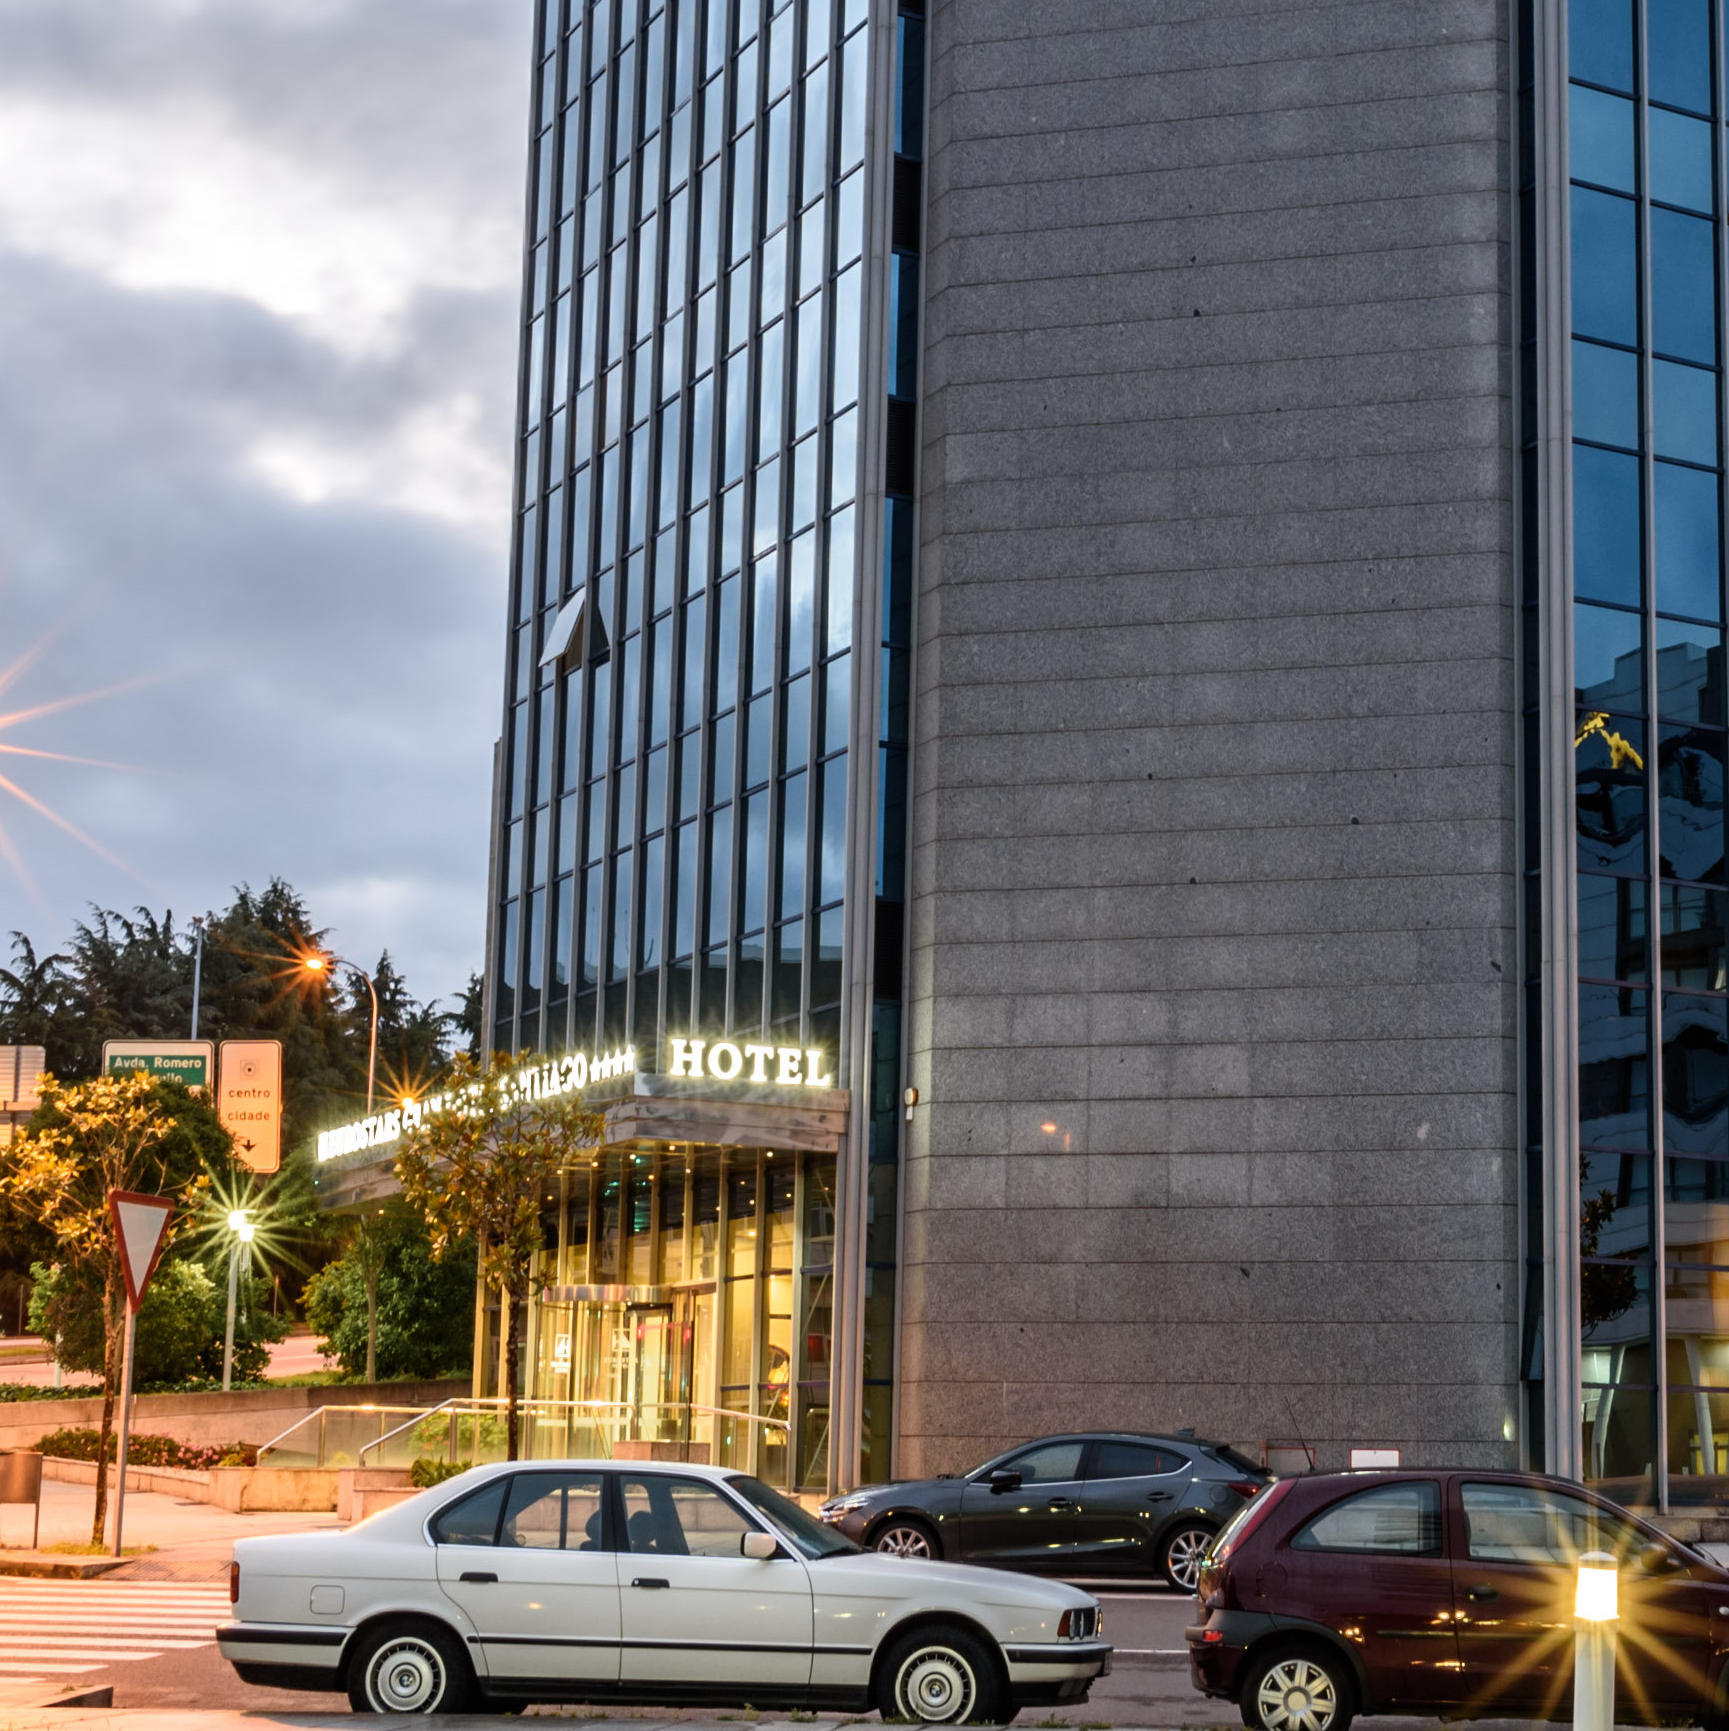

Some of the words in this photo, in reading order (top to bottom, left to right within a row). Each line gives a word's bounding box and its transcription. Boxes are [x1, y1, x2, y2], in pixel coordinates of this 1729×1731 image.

[114, 1056, 149, 1069] Avda.
[154, 1056, 202, 1069] Romero
[670, 1038, 830, 1087] HOTEL
[228, 1088, 271, 1099] centro
[227, 1111, 271, 1121] cidade
